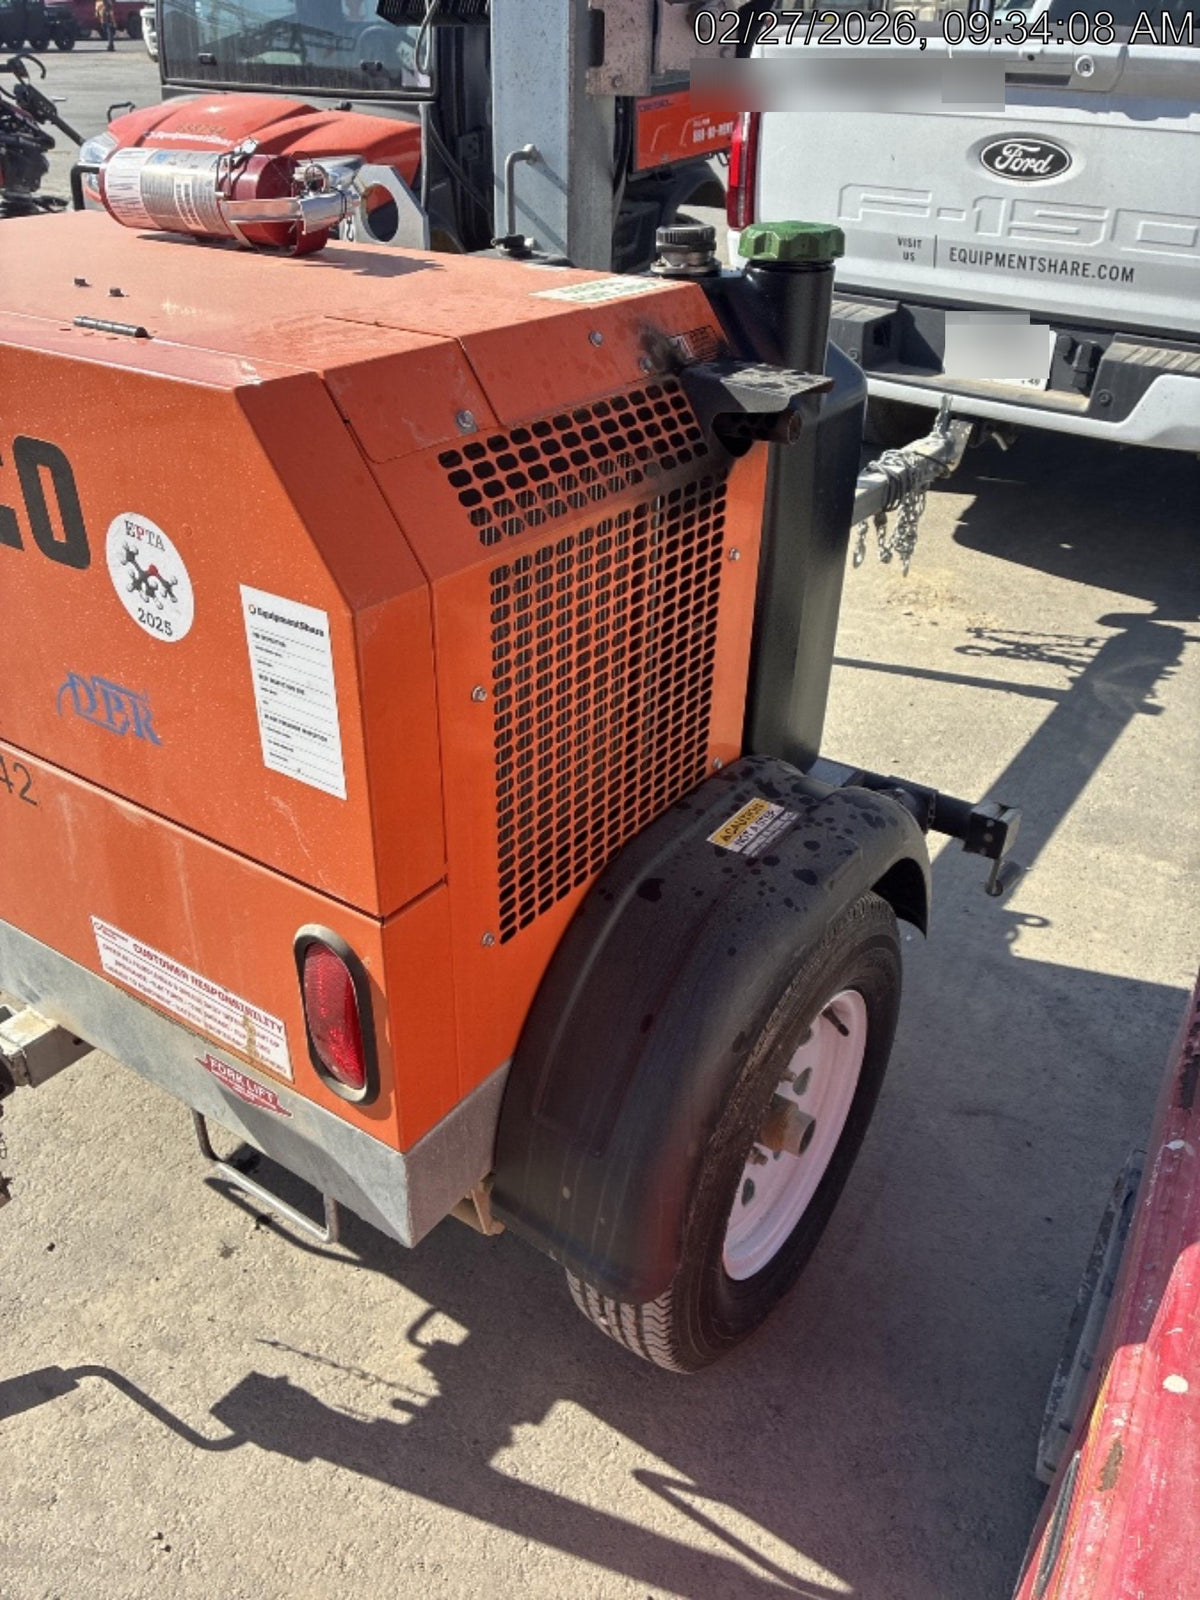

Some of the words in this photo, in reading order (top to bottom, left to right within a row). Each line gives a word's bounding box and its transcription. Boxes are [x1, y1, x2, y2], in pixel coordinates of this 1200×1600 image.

[994, 143, 1054, 174] Ford
[837, 183, 1200, 258] F-150
[897, 236, 922, 249] VISIT
[903, 251, 915, 262] US
[949, 246, 1135, 282] EQUIPMENTSHARE.COM
[125, 520, 166, 552] EPTA
[138, 607, 172, 637] 2025
